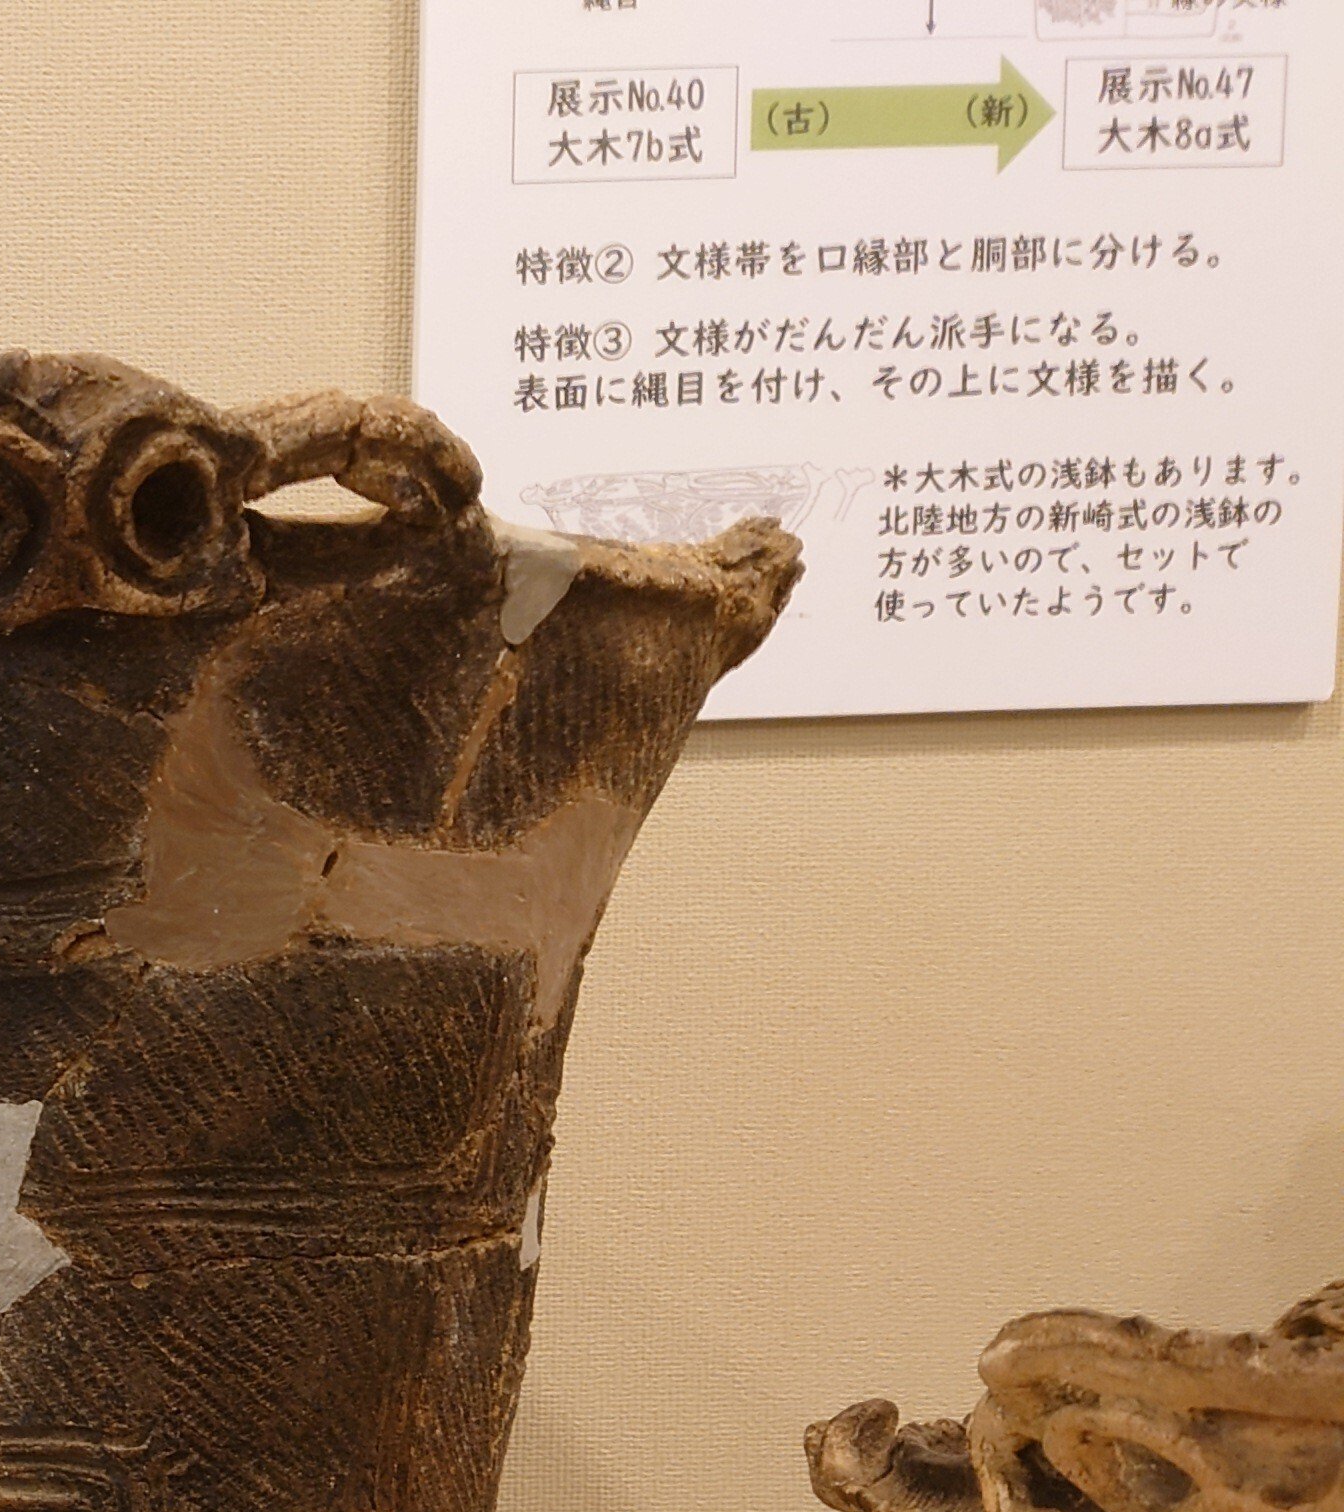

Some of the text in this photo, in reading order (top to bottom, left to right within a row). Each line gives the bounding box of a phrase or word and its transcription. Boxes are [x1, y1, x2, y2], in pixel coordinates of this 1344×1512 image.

[547, 132, 703, 168] 大木7b式
[1096, 116, 1251, 153] 大木8a式
[655, 232, 1224, 279] 文様帯を口縁部と胴部に分ける。
[654, 310, 1141, 356] 文様がだんだん派手になる。
[878, 496, 1282, 536] 北陸地方の新崎式の浅鉢の
[874, 582, 1193, 623] 使っていたようです。
